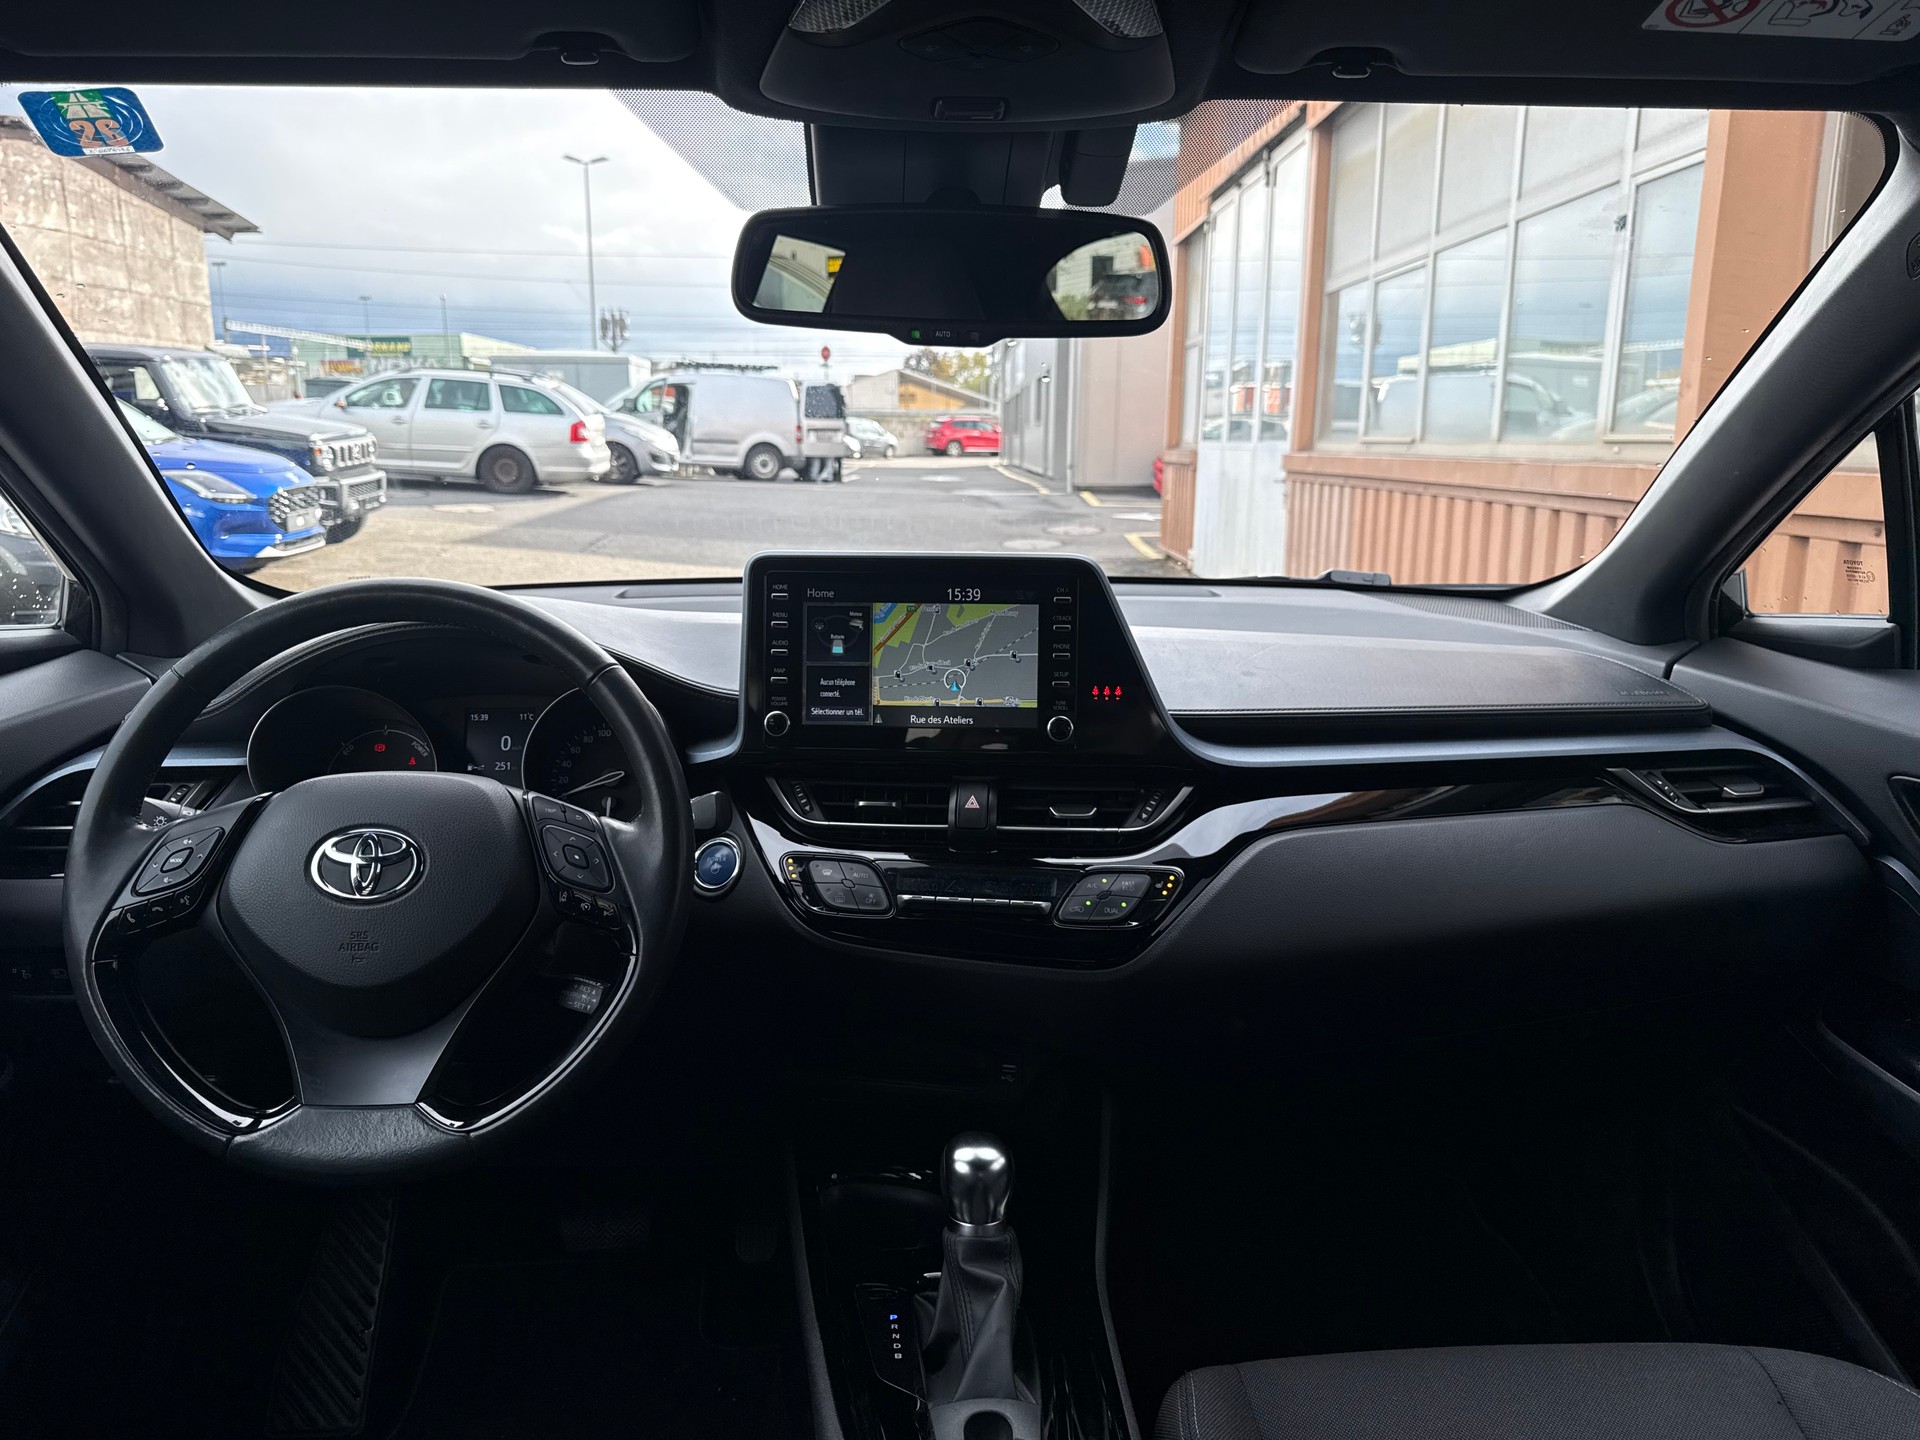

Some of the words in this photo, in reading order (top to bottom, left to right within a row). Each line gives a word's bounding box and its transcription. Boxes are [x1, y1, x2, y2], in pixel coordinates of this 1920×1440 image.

[807, 587, 835, 598] Home
[947, 588, 981, 601] 15:39
[820, 677, 834, 686] Aucun
[834, 677, 856, 687] téléphone
[811, 707, 845, 716] Sélectionner
[854, 707, 864, 716] tél.
[470, 713, 489, 721] 15:39
[910, 715, 927, 724] Rue
[927, 715, 942, 724] des
[943, 715, 974, 724] Ateliers
[599, 729, 611, 737] 100
[500, 735, 512, 751] 0
[583, 735, 594, 743] 80
[342, 744, 354, 756] ECO
[411, 740, 429, 757] POWER
[570, 746, 581, 754] 60
[495, 761, 511, 771] 251
[560, 760, 572, 768] 40
[558, 776, 569, 784] 20
[1104, 906, 1119, 914] DUAL
[350, 931, 369, 940] SRS
[338, 942, 380, 952] AIRBAG
[579, 984, 592, 993] RES
[573, 1001, 586, 1010] SET
